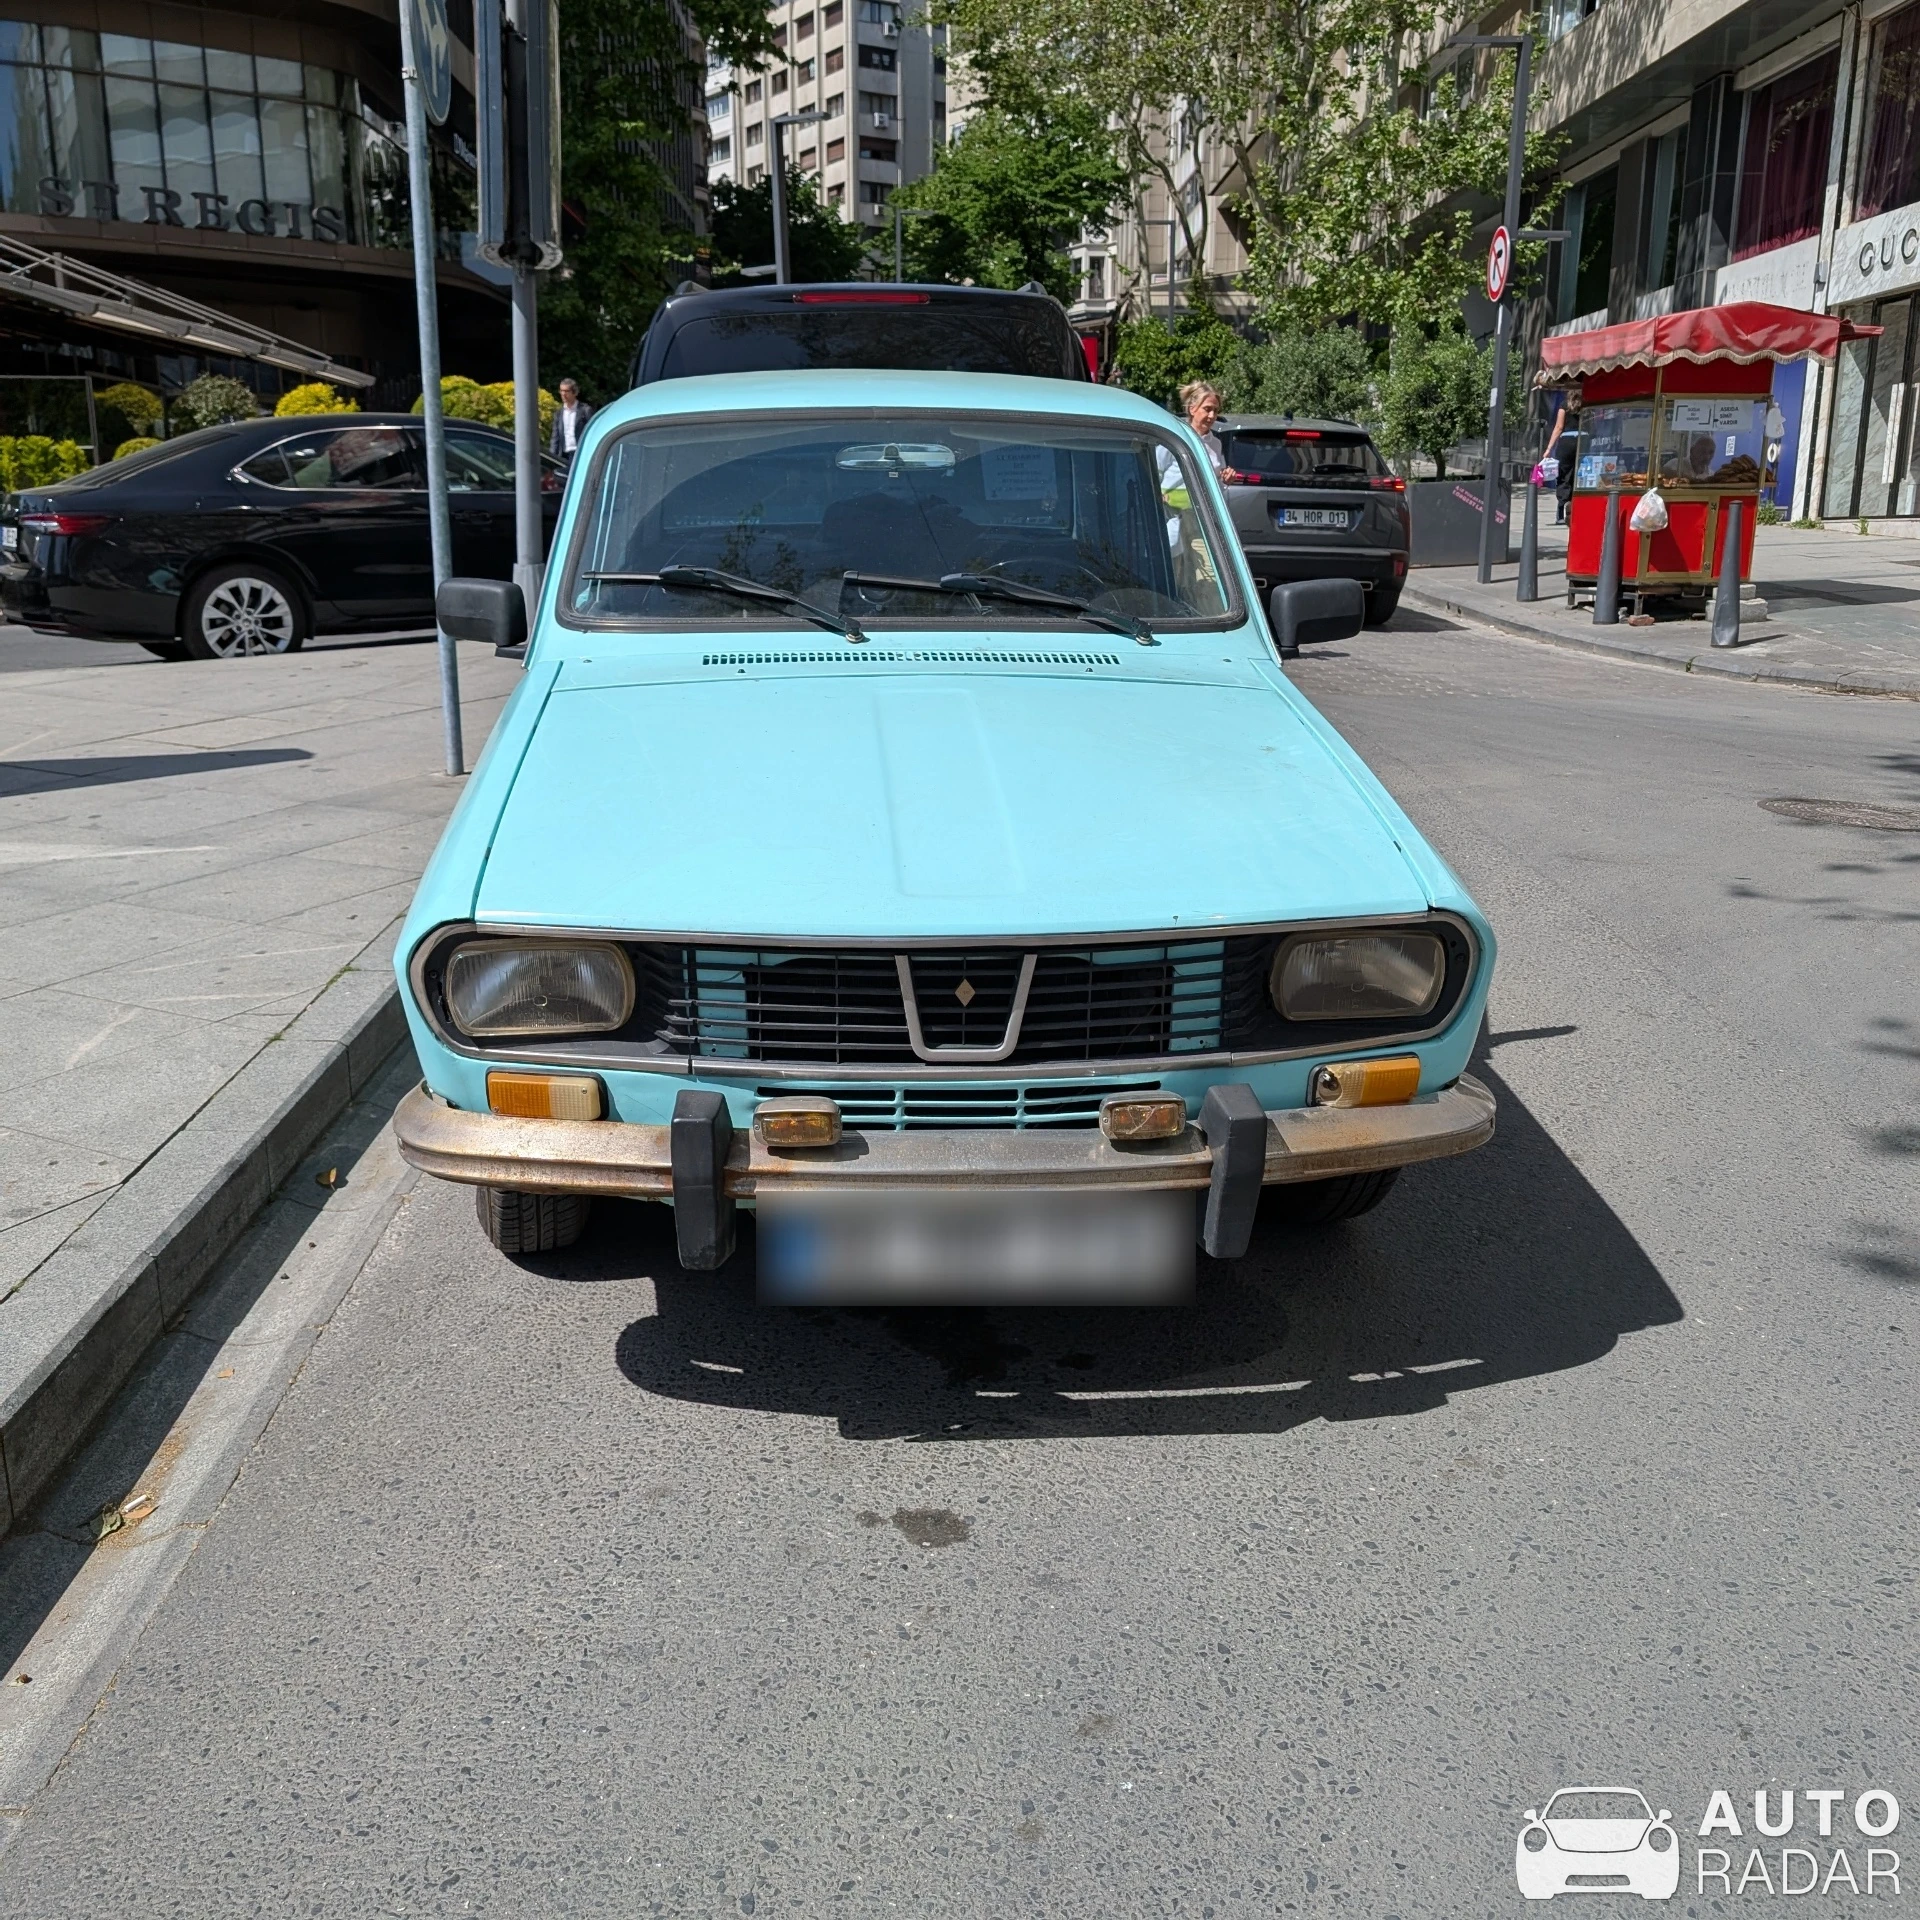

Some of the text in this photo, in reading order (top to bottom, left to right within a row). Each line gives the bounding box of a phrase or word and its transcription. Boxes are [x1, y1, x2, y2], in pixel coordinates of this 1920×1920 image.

[140, 186, 346, 244] REGIS
[1859, 228, 1919, 276] GUC
[1285, 510, 1346, 523] 34 HOR 013
